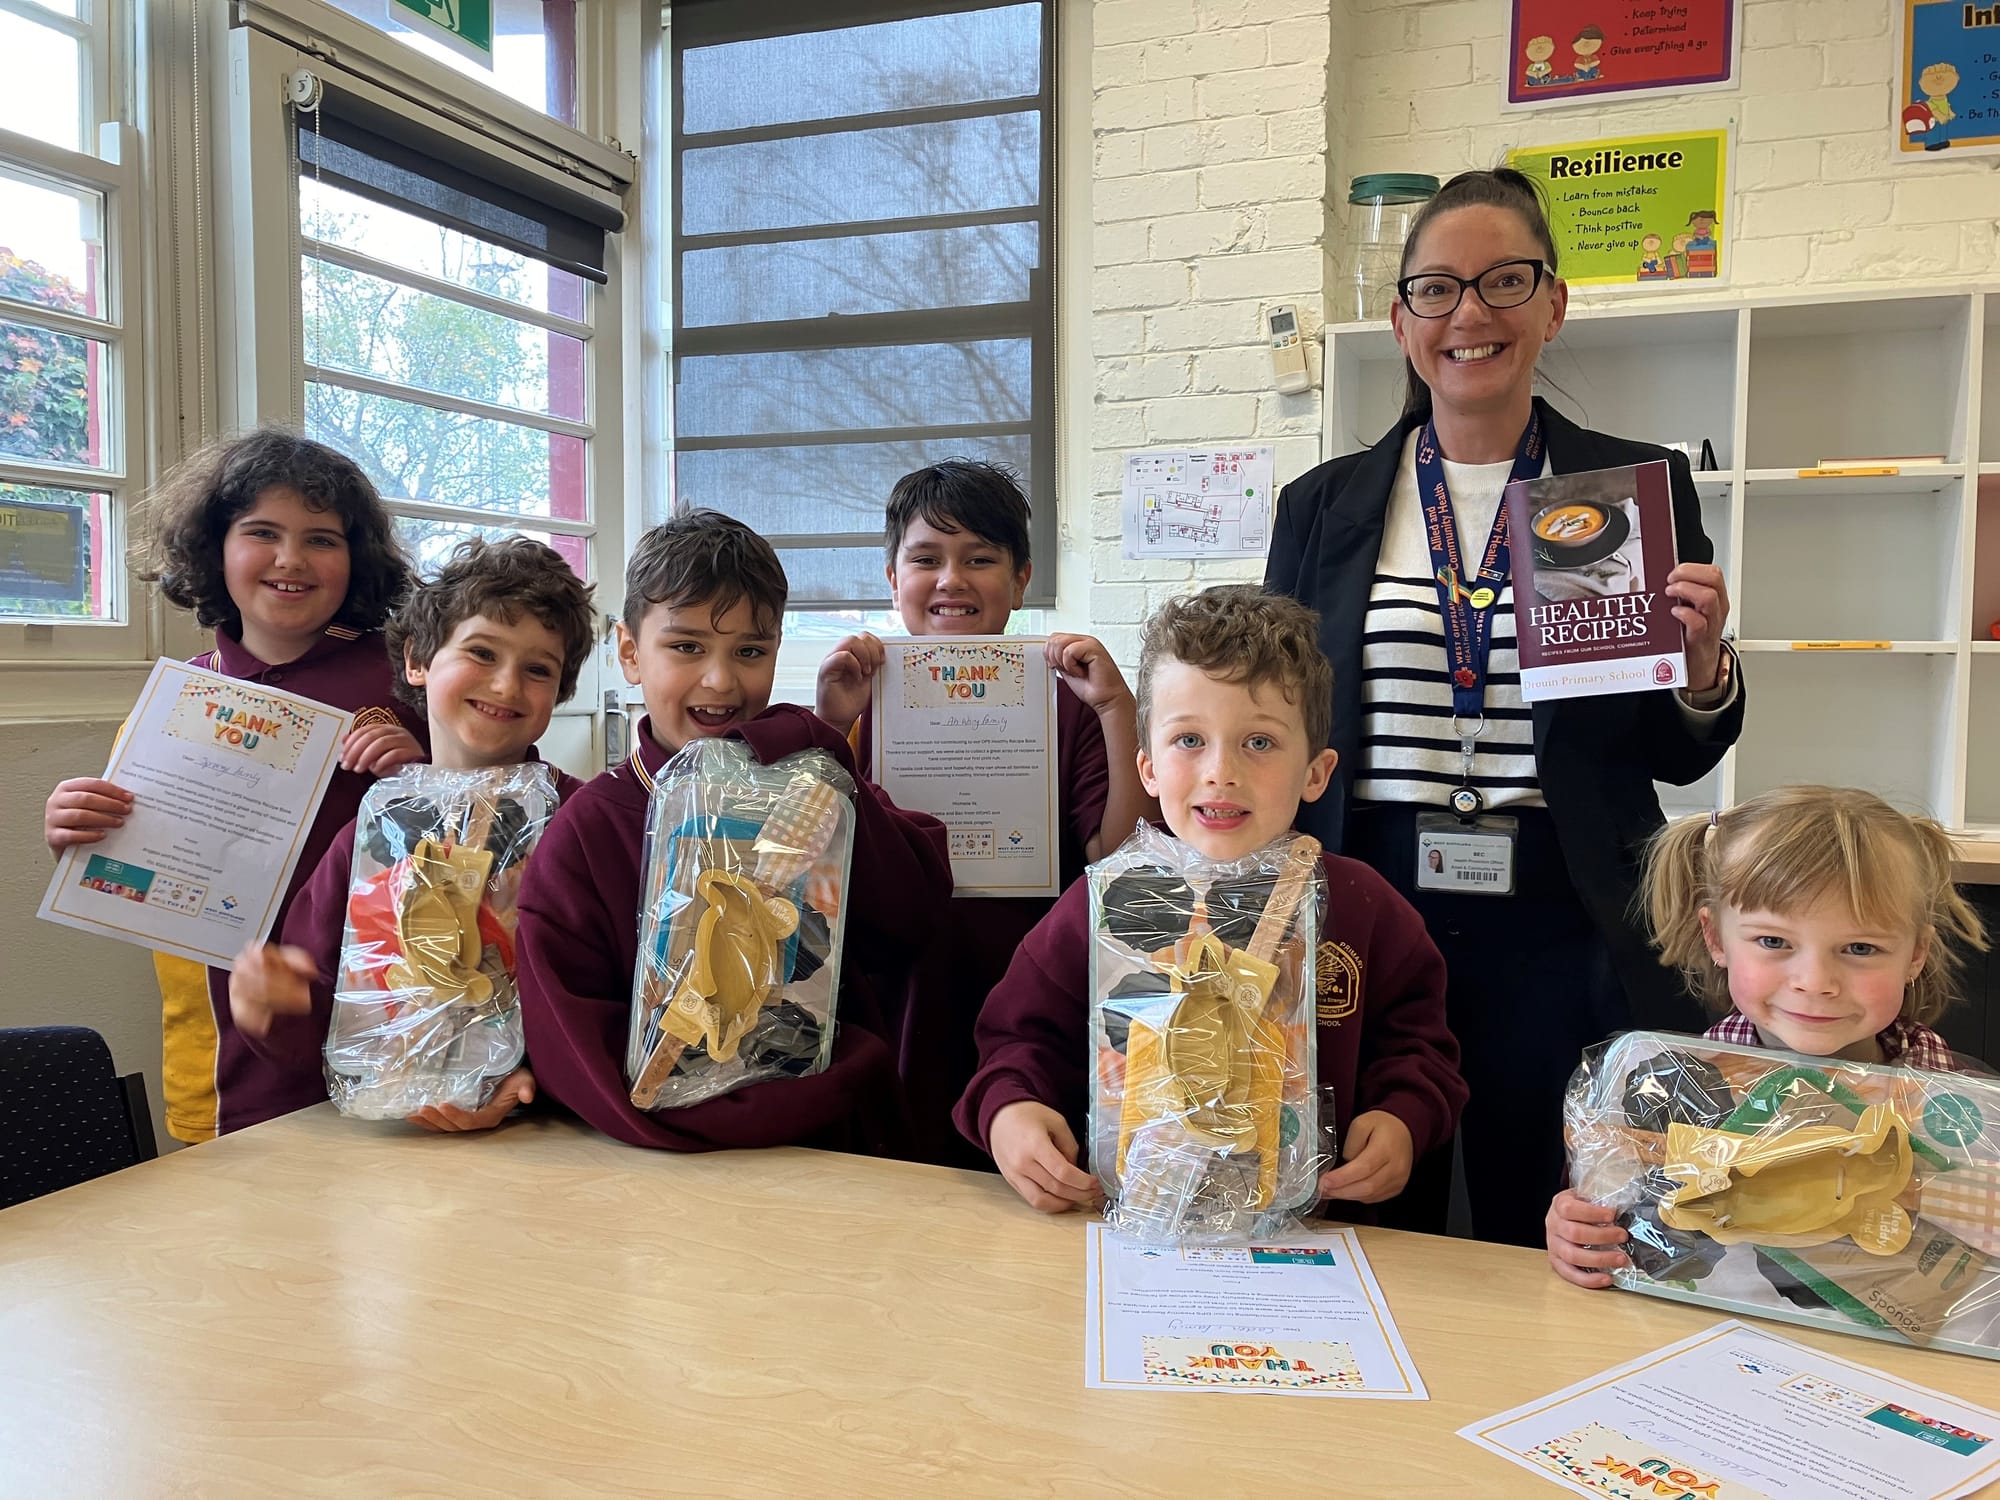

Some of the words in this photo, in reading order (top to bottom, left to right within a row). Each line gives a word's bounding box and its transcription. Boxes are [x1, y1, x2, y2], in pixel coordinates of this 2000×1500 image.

[1632, 9, 1656, 20] Keep
[1632, 22, 1687, 36] Determined
[1610, 46, 1632, 56] Give
[1634, 41, 1684, 54] everything
[1696, 40, 1708, 50] go
[1550, 150, 1683, 178] Resilience
[1563, 192, 1589, 202] Learn
[1592, 189, 1613, 199] from
[1616, 185, 1658, 197] mistakes
[1579, 207, 1614, 217] Bounce
[1617, 203, 1640, 214] back
[1575, 223, 1602, 234] Think
[1577, 241, 1603, 251] Never
[1607, 240, 1625, 251] give
[1628, 240, 1639, 250] up
[1433, 482, 1449, 513] Health
[1425, 506, 1438, 522] and
[1428, 524, 1443, 551] Allied
[1441, 515, 1459, 571] Community
[1484, 535, 1502, 567] Health
[1529, 593, 1655, 627] HEALTHY
[1540, 616, 1648, 646] RECIPES
[1460, 620, 1472, 664] HEALTHCARE
[1617, 641, 1650, 649] COMMUNITY
[1455, 642, 1464, 664] WEST
[928, 665, 1000, 681] THANK
[1562, 674, 1605, 686] Primary
[1609, 669, 1646, 681] School
[944, 683, 985, 698] YOU
[204, 701, 283, 738] THANK
[213, 725, 260, 750] YOU
[1890, 1206, 1902, 1235] Alex
[1869, 1290, 1920, 1333] Sponge
[1209, 1343, 1283, 1358] YOU
[1186, 1356, 1315, 1372] THANK
[1638, 1459, 1722, 1500] YOU
